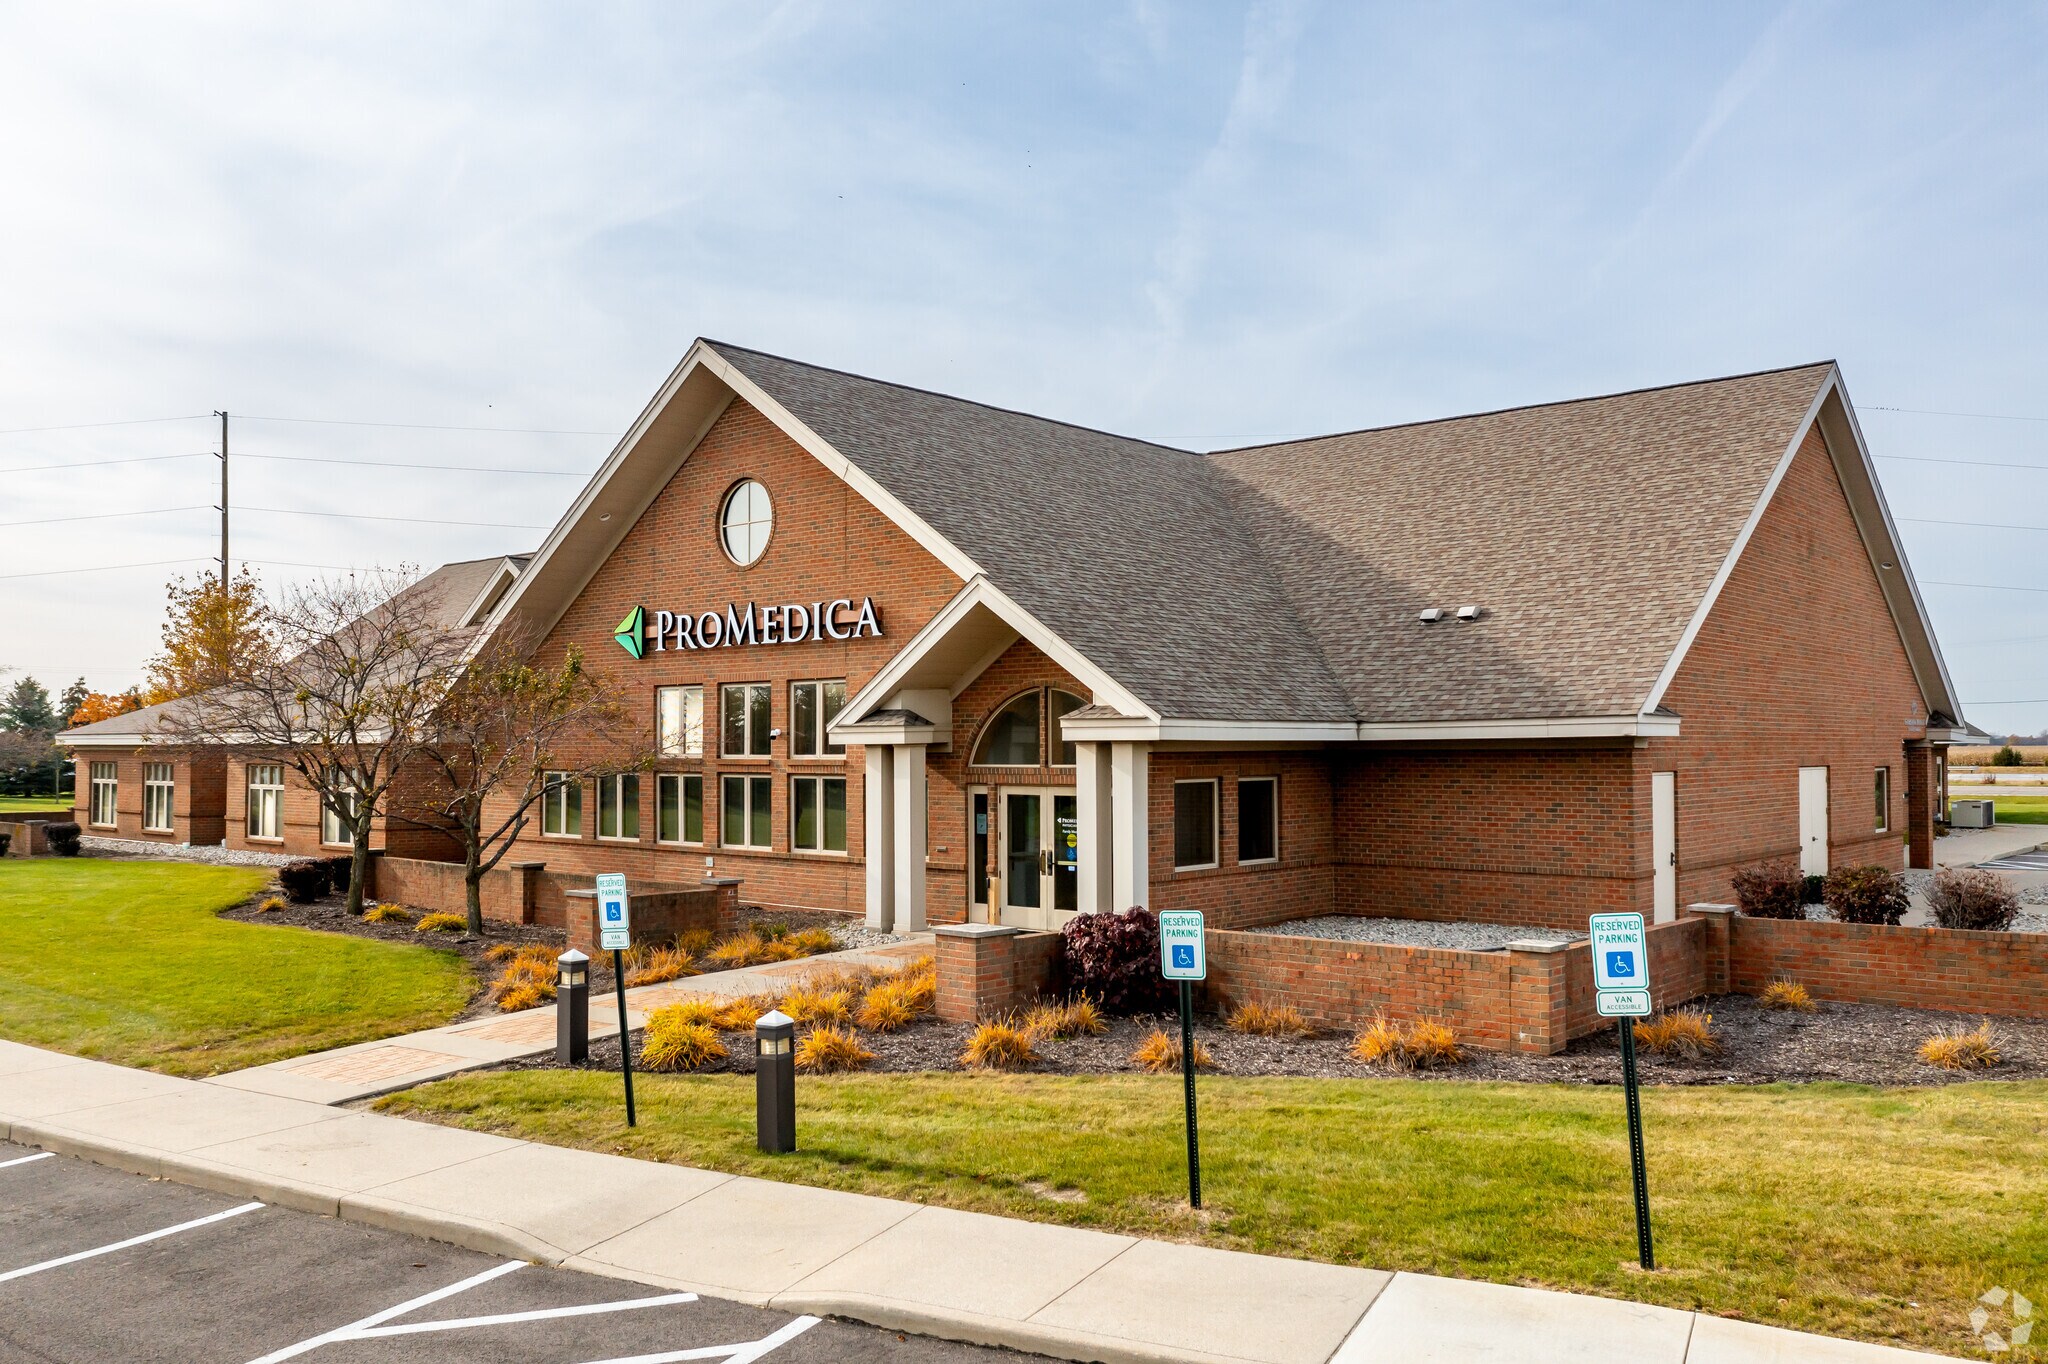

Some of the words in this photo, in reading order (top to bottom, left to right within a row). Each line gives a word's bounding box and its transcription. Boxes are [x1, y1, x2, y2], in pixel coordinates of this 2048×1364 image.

[599, 879, 623, 887] RESERVED
[1163, 917, 1199, 926] RESERVED
[1594, 920, 1639, 931] RESERVED
[1166, 929, 1198, 938] PARKING
[1599, 933, 1638, 943] PARKING
